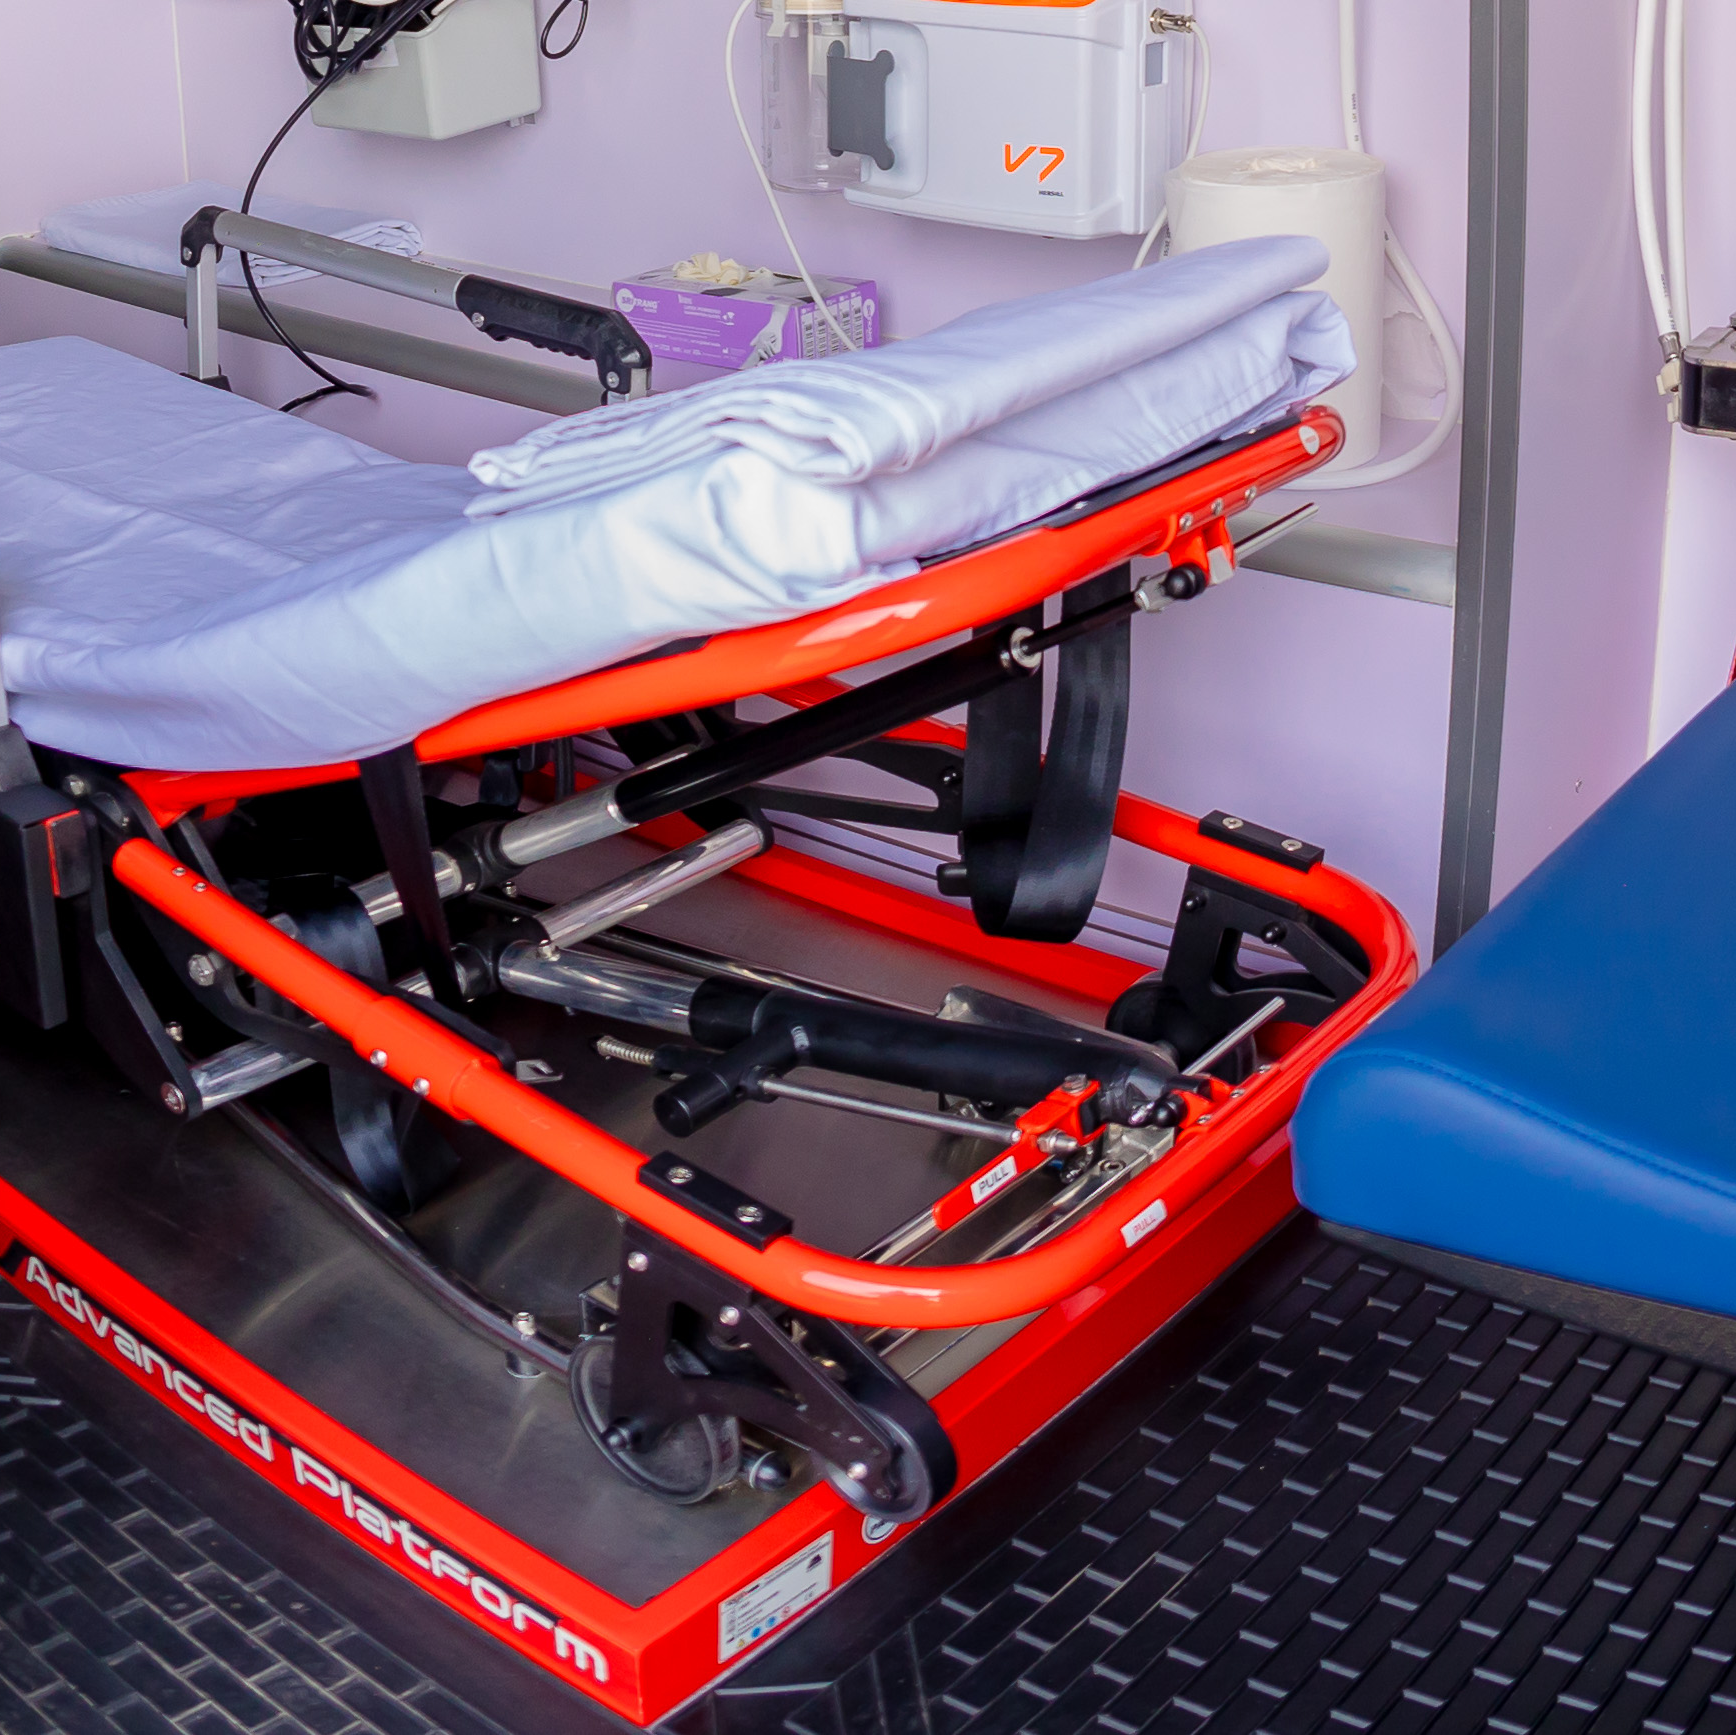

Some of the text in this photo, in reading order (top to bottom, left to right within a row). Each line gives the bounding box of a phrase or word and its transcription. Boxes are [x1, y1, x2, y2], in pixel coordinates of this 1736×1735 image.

[1004, 143, 1065, 184] V7
[978, 1166, 1011, 1195] PULL
[1132, 1216, 1157, 1236] PULL
[25, 1255, 276, 1463] Advanced
[291, 1446, 611, 1684] Platform
